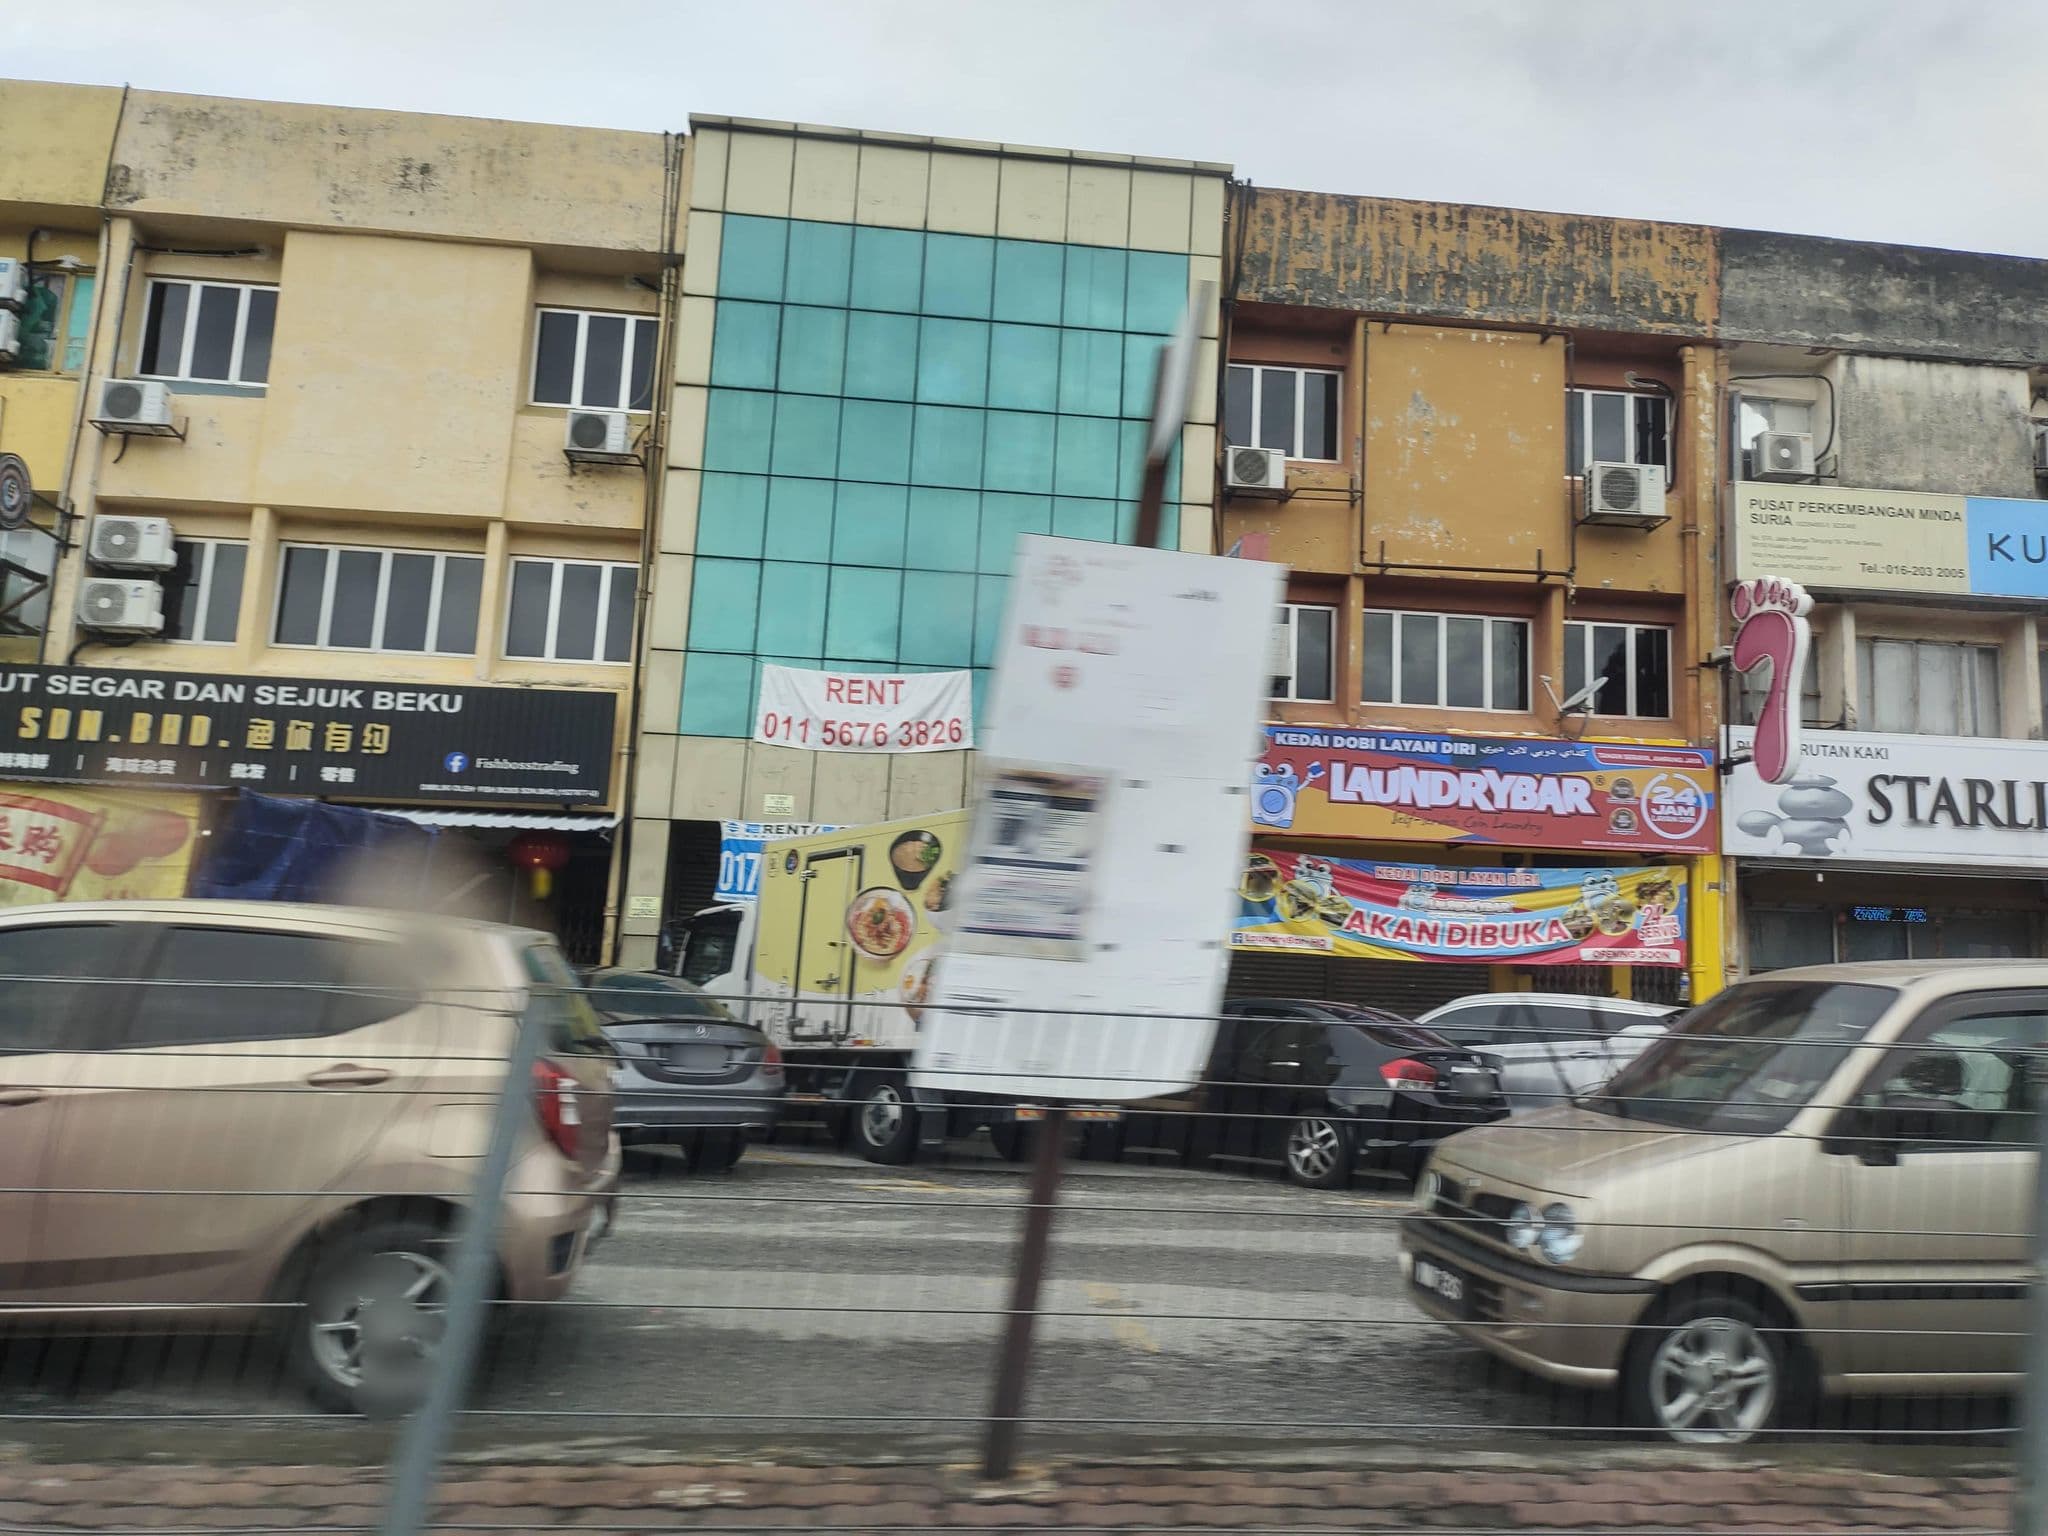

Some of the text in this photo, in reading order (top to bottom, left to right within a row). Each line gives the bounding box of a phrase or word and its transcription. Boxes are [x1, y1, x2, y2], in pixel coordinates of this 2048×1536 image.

[1749, 498, 1963, 522] PUSAT PERKEMBANGAN MINDA
[1750, 513, 1793, 526] SURIA
[1936, 567, 1966, 579] 2005
[45, 674, 165, 700] SEGAR
[173, 680, 245, 703] DAN
[253, 684, 365, 709] SEJUK
[371, 690, 463, 713] BEKU
[825, 677, 905, 705] RENT
[763, 712, 963, 747] 011 5676 3826
[1275, 732, 1477, 757] KEDAI DOBI LAYAN DIRI
[1799, 743, 1889, 760] RUTAN KAKI
[1329, 759, 1600, 817] LAUNDRYBAR
[1651, 785, 1697, 805] 24
[1650, 805, 1697, 817] JAM
[718, 850, 762, 893] 017
[1374, 866, 1542, 888] KEDAI DOBI LAYAN DIRI
[1343, 908, 1570, 948] AKAN DIBUKA
[1639, 950, 1672, 961] SOON
